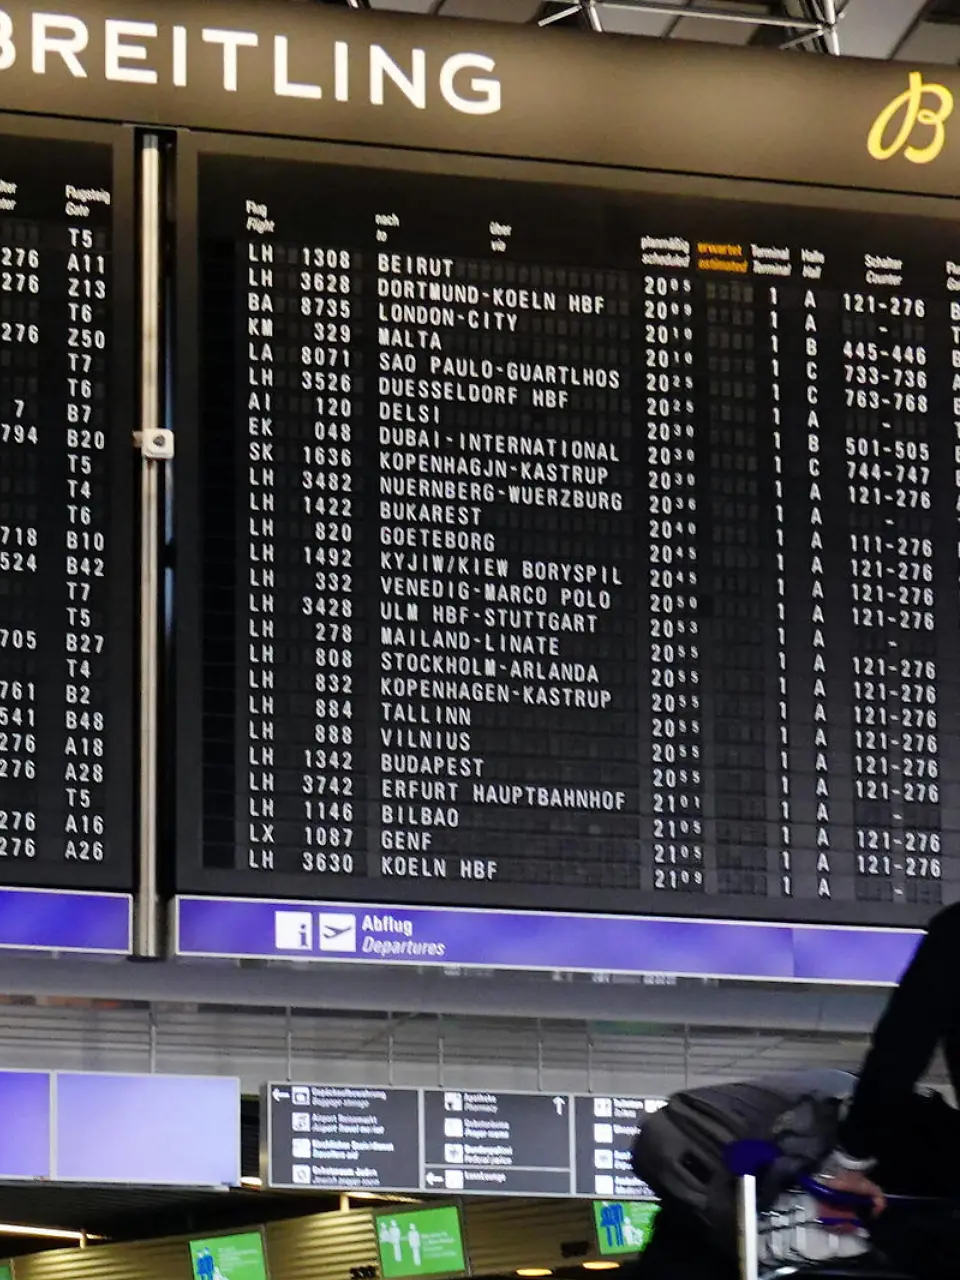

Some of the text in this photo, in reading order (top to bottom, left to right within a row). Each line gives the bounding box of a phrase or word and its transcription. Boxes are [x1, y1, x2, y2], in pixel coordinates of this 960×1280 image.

[302, 247, 454, 278] 1308 BEIRUT
[68, 277, 106, 299] Z13
[377, 277, 605, 315] DORTMUND-KOELN HBF
[300, 296, 518, 332] 8735 LONDON-CITY
[67, 327, 105, 349] Z50
[378, 327, 442, 351] MALTA
[301, 346, 620, 389] 8071 SAO PAULO-GUARTLHOS
[379, 376, 568, 409] DUESSELDORF HBF
[379, 401, 439, 424] DELSI
[67, 428, 105, 450] B20
[379, 426, 620, 462] DUBAI-INTERNATIONAL
[303, 446, 608, 485] 1636 KOPENHAGJN-KASTRUP
[380, 476, 622, 511] NUERNBERG-WUERZBURG
[380, 501, 482, 526] BUKAREST
[66, 530, 104, 552] B10
[380, 526, 495, 552] GOETEBORG
[304, 546, 622, 585] 1492 KYJIW/KIEW BORYSPIL
[380, 575, 611, 610] VENEDIG-MARCO POLO
[380, 601, 598, 633] ULM HBF-STUTTGART
[315, 622, 559, 656] 278 MAILAND-LINATE
[381, 651, 599, 683] STOCKHOLM-ARLANDA
[315, 673, 612, 709] 832 KOPENHAGEN-KASTRUP
[381, 702, 471, 726] TALLINN
[380, 728, 471, 751] VILNIUS
[304, 749, 484, 777] 1342 BUDAPEST
[382, 778, 625, 810] ERFURT HAUPTBAHNHOF
[304, 800, 459, 828] 1146 BILBAO
[64, 840, 104, 861] A26
[381, 830, 432, 851] GENF
[302, 851, 497, 880] 3630 KOELN HBF
[362, 915, 412, 937] Abflug
[362, 936, 445, 956] Departures
